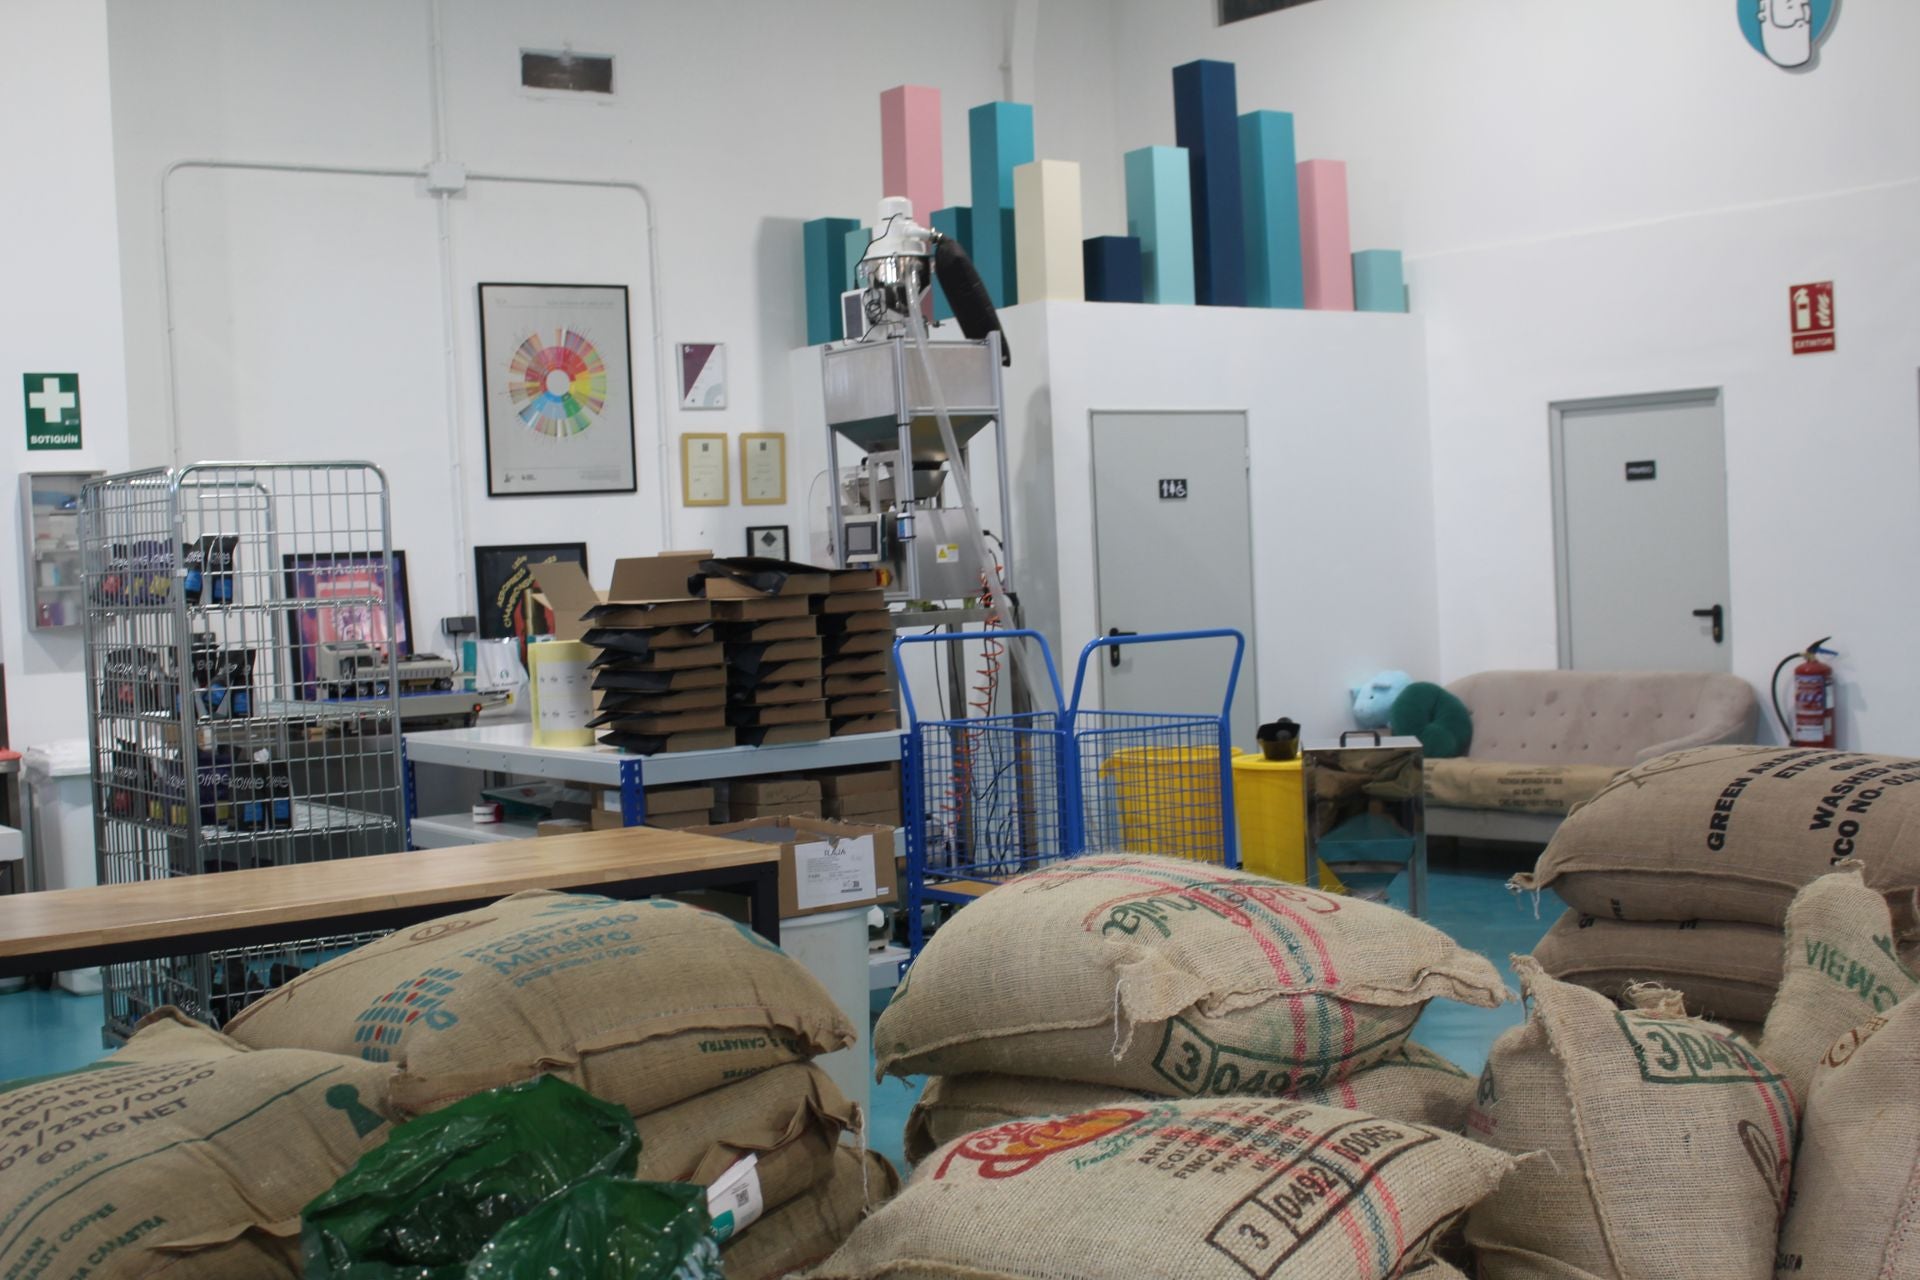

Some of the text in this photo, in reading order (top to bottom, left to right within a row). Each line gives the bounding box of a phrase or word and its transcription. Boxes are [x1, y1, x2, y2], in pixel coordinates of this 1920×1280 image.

[30, 432, 78, 445] BOTIQUÍN
[1707, 777, 1754, 851] GREEN
[1808, 766, 1891, 830] WASHED
[494, 930, 631, 975] Mineiro
[495, 914, 638, 955] Cerrado
[1175, 1041, 1201, 1082] 3
[1647, 1032, 1679, 1072] 3
[36, 1096, 190, 1165] 60 KG NET
[1173, 1148, 1220, 1180] FINCA
[1238, 1223, 1270, 1251] 3
[1273, 1165, 1340, 1220] 0492
